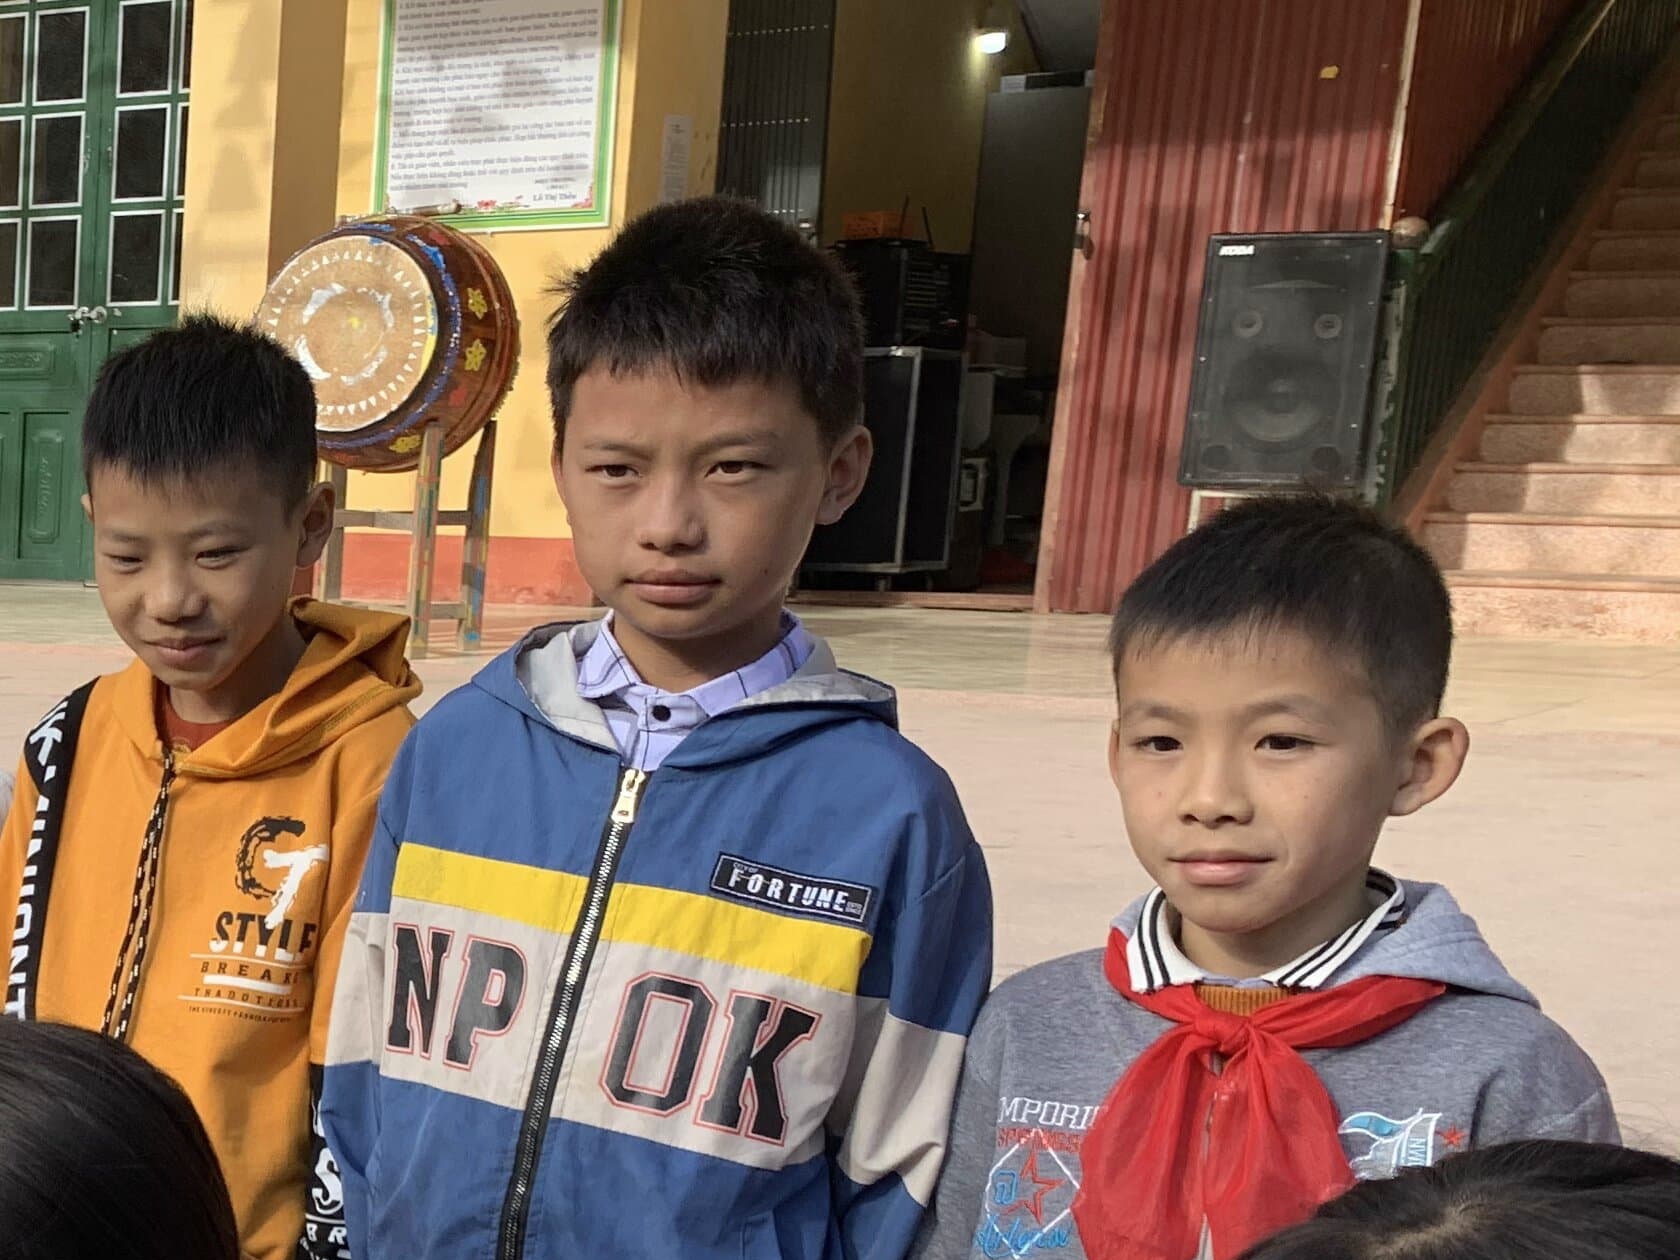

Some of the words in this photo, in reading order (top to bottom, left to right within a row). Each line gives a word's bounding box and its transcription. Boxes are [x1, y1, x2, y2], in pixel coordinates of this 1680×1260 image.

[728, 868, 849, 912] FORTUNE
[209, 911, 317, 962] STYLE
[385, 922, 527, 1071] NP
[599, 971, 823, 1147] OK
